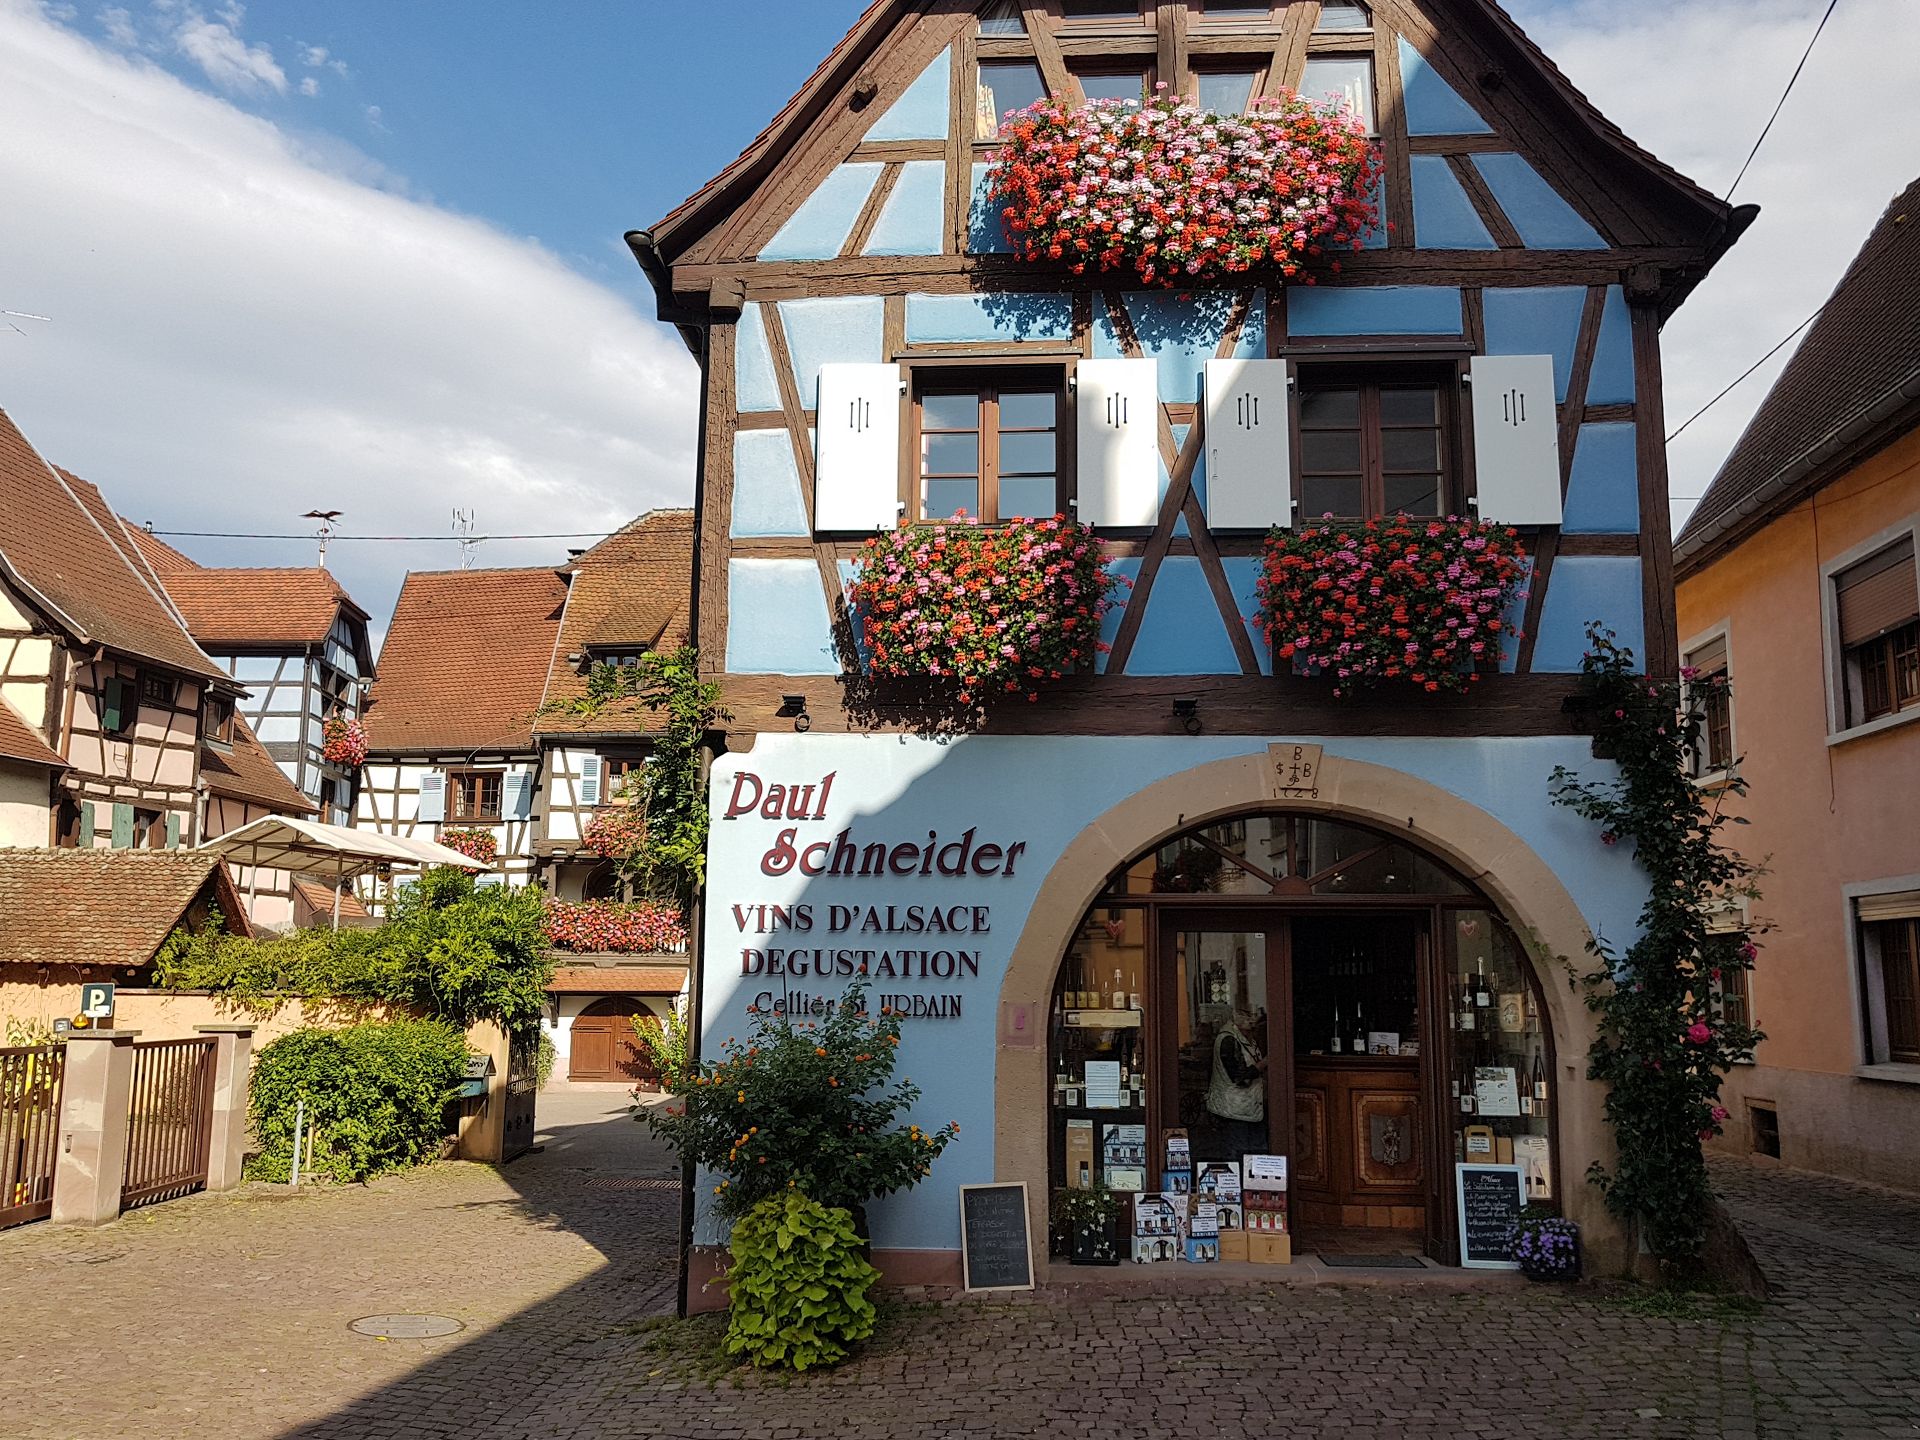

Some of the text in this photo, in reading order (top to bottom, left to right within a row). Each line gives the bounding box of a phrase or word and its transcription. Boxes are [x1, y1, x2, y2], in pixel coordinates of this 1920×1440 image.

[723, 771, 837, 821] Paul
[760, 827, 1026, 876] Schneider
[732, 904, 991, 933] VINS D'ALSACE
[740, 949, 981, 978] DEGUSTATION
[89, 989, 106, 1012] P
[880, 995, 962, 1016] URBAIN
